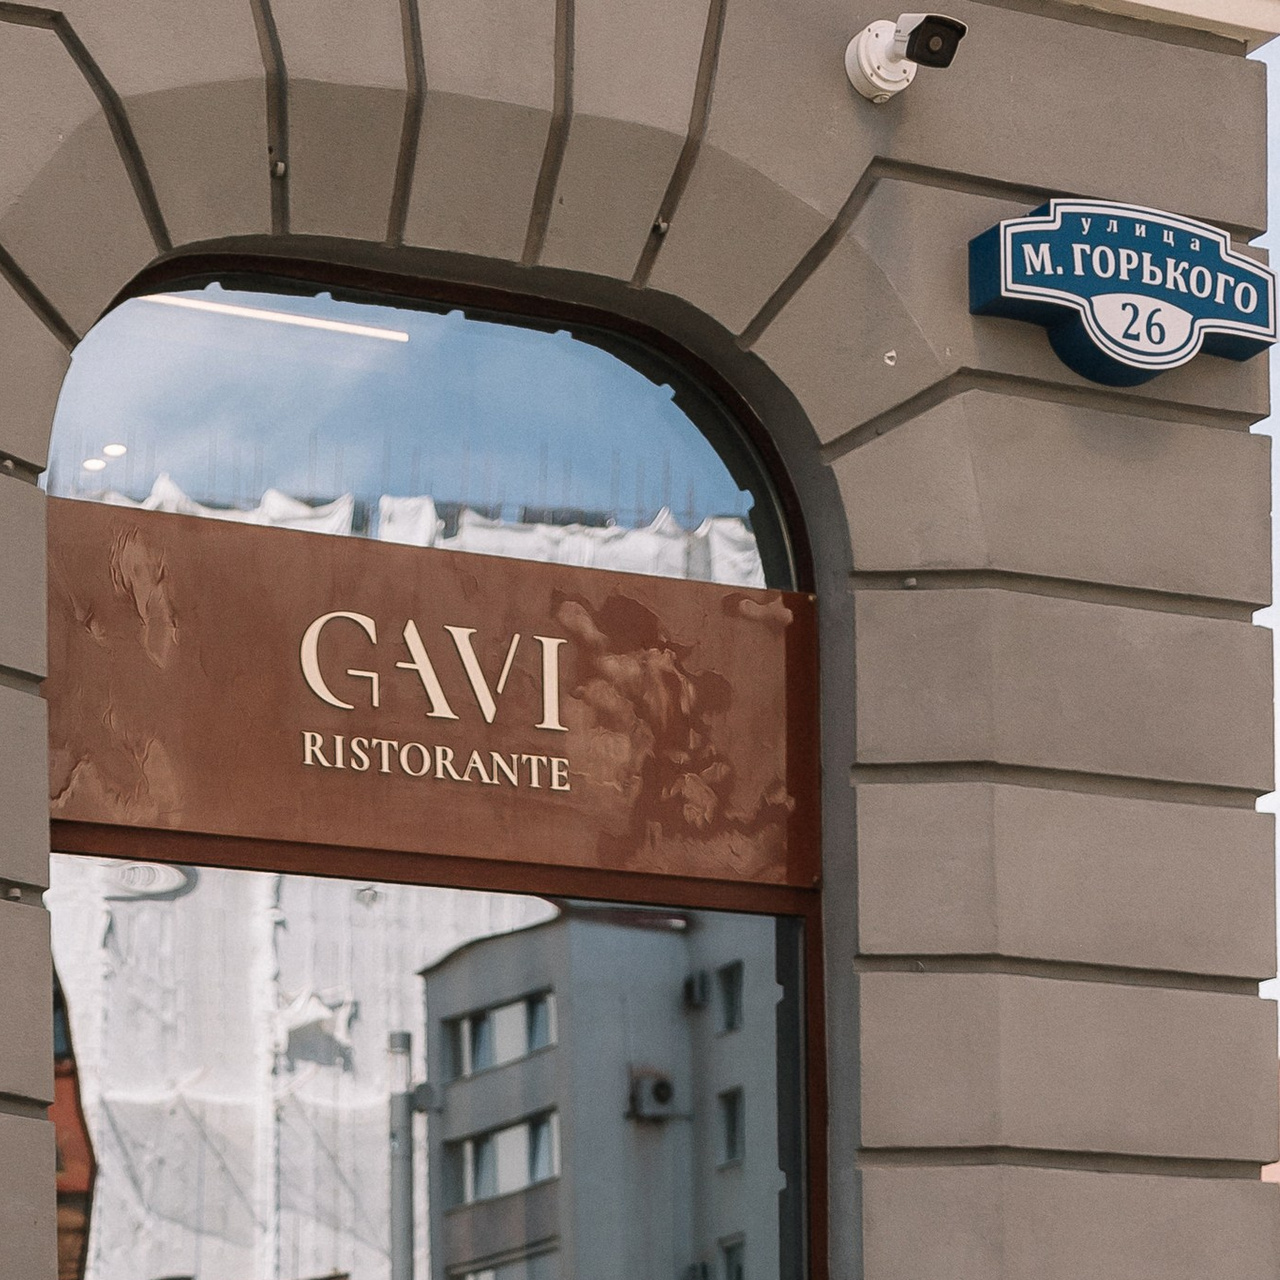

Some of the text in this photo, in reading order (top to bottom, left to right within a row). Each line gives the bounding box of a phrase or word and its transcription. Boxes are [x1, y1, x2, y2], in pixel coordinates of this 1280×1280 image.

[1080, 216, 1201, 252] улица
[1021, 242, 1258, 315] М. ГОРЬКОГО
[1120, 301, 1166, 345] 26
[299, 610, 570, 732] GAVI
[301, 730, 571, 792] RISTORANTE
